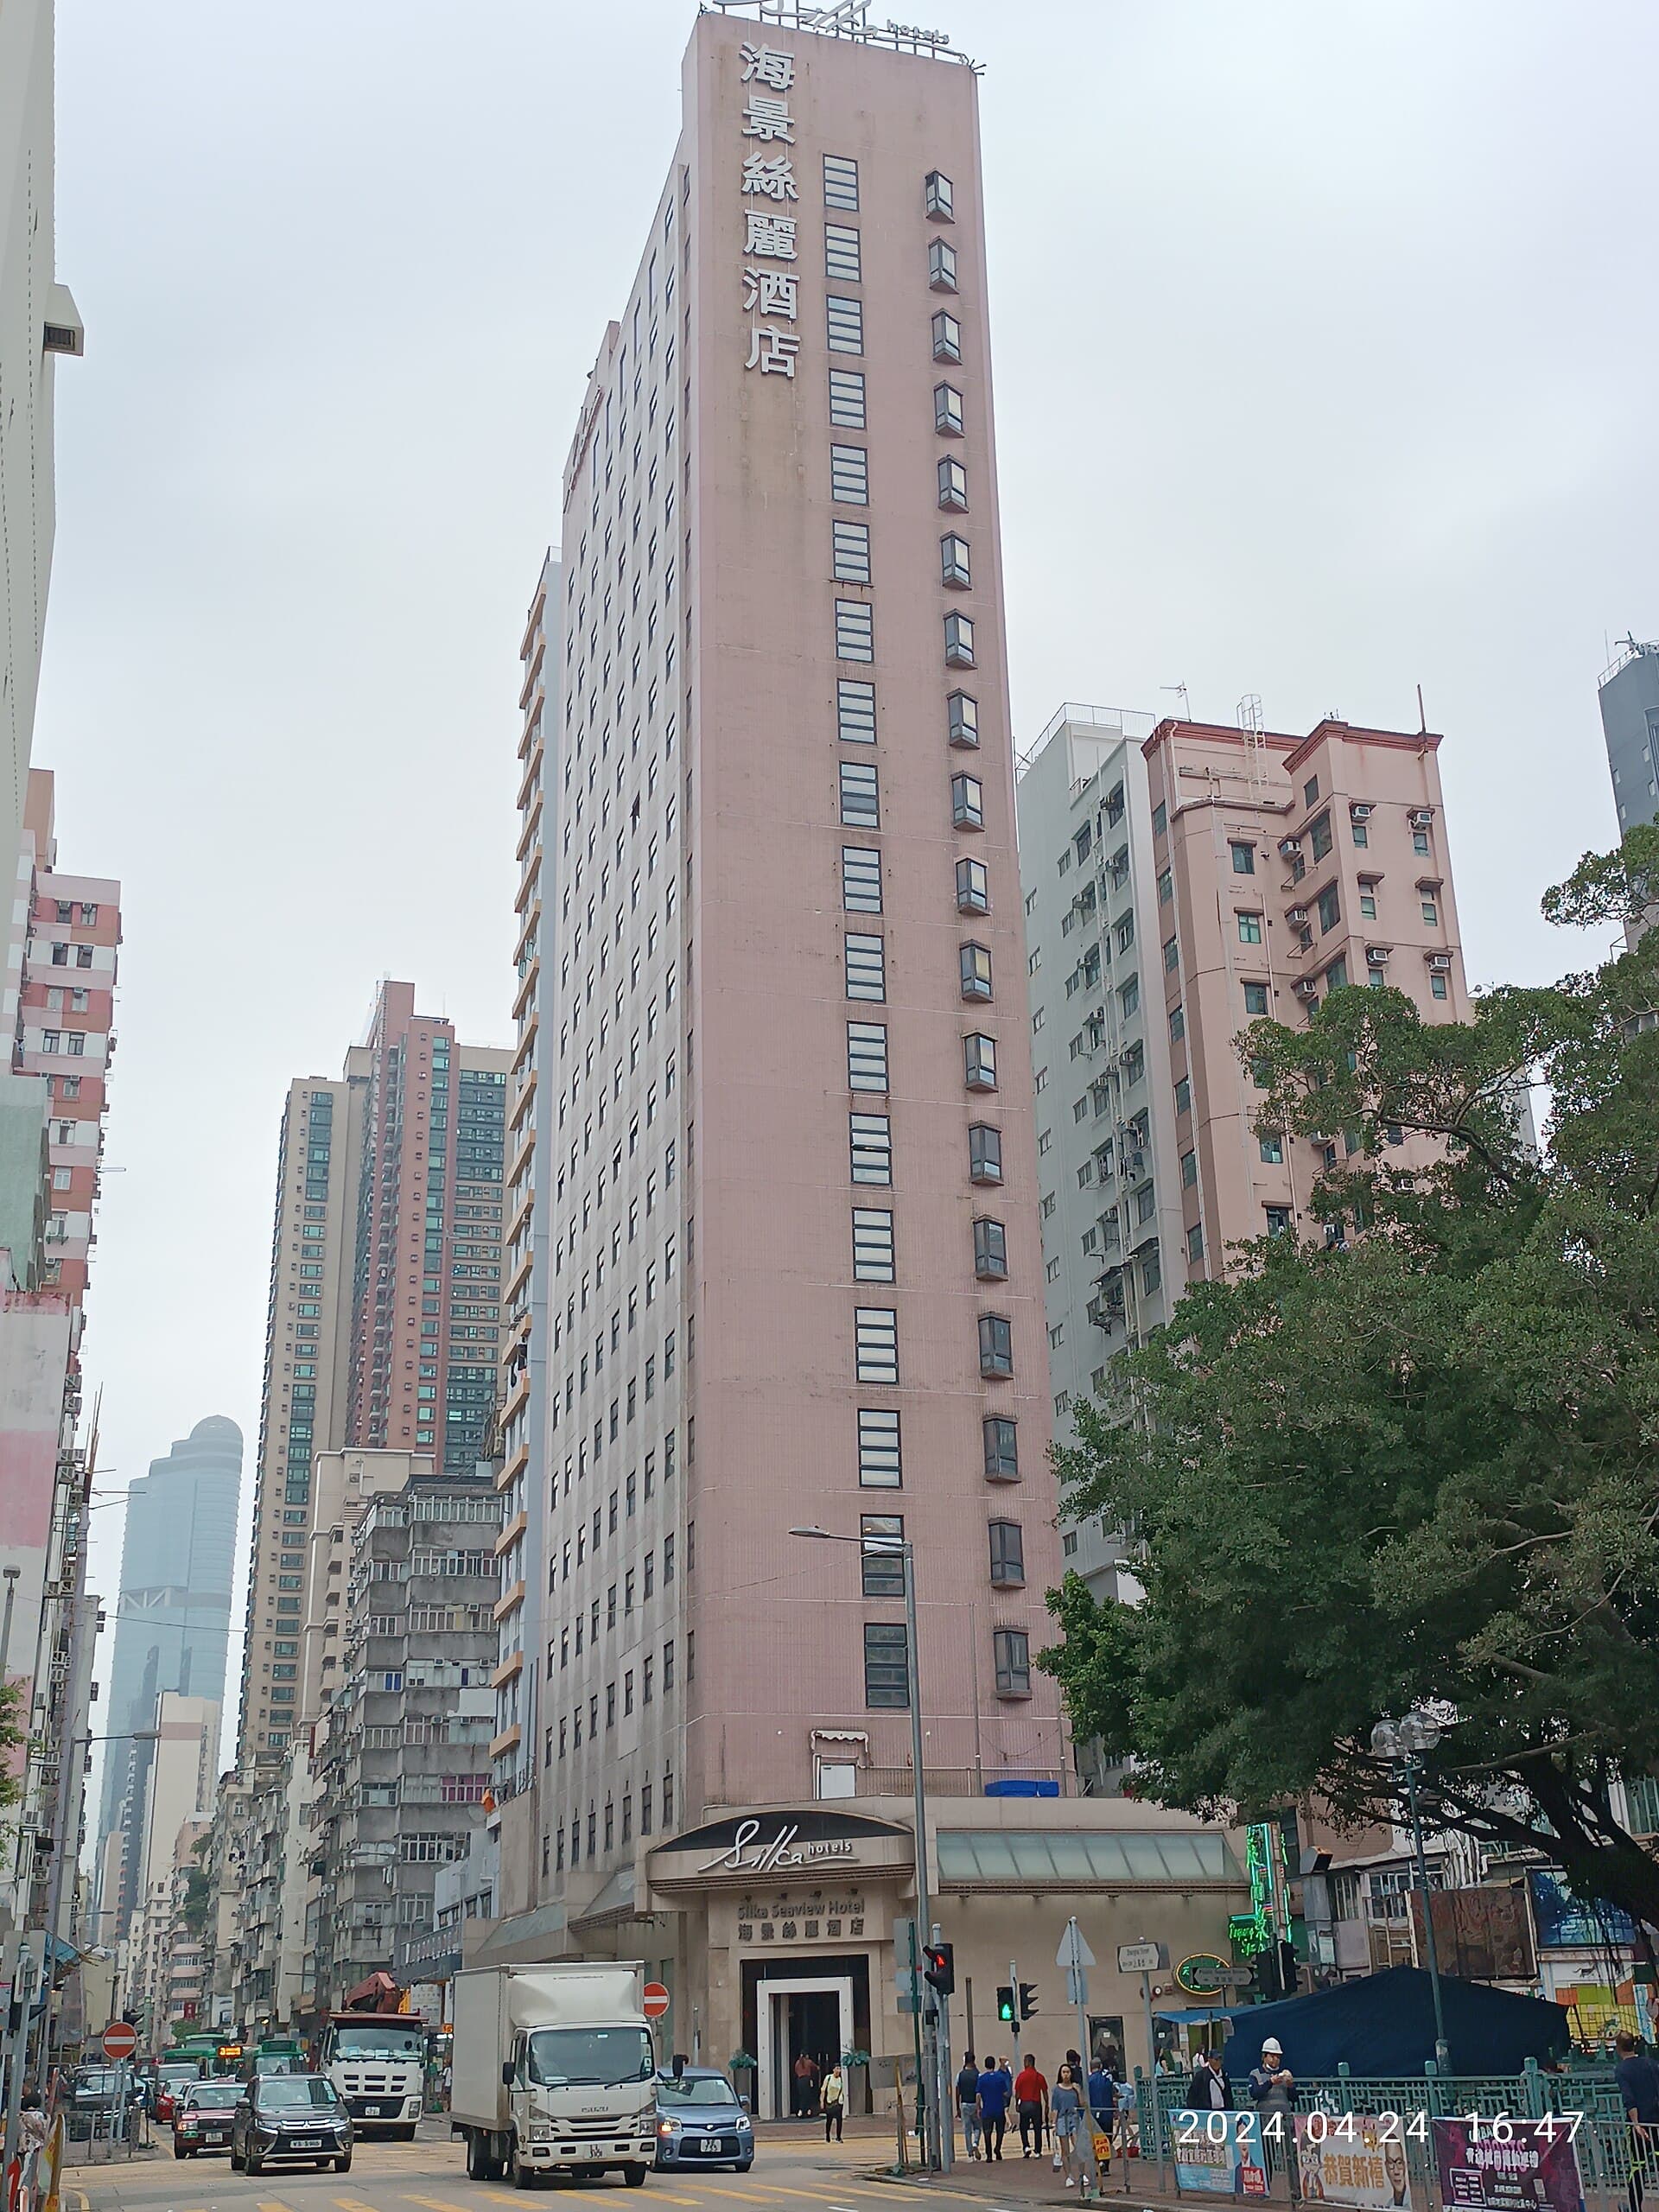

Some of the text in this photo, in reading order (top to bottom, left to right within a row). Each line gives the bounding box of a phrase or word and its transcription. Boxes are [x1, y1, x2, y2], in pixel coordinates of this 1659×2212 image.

[887, 19, 950, 44] hotels
[739, 41, 800, 378] 海景絲麗酒店
[698, 1820, 852, 1871] Silka hotels
[738, 1899, 864, 1921] Silka Seaview Hotel
[1323, 2152, 1385, 2190] 恭賀新禧
